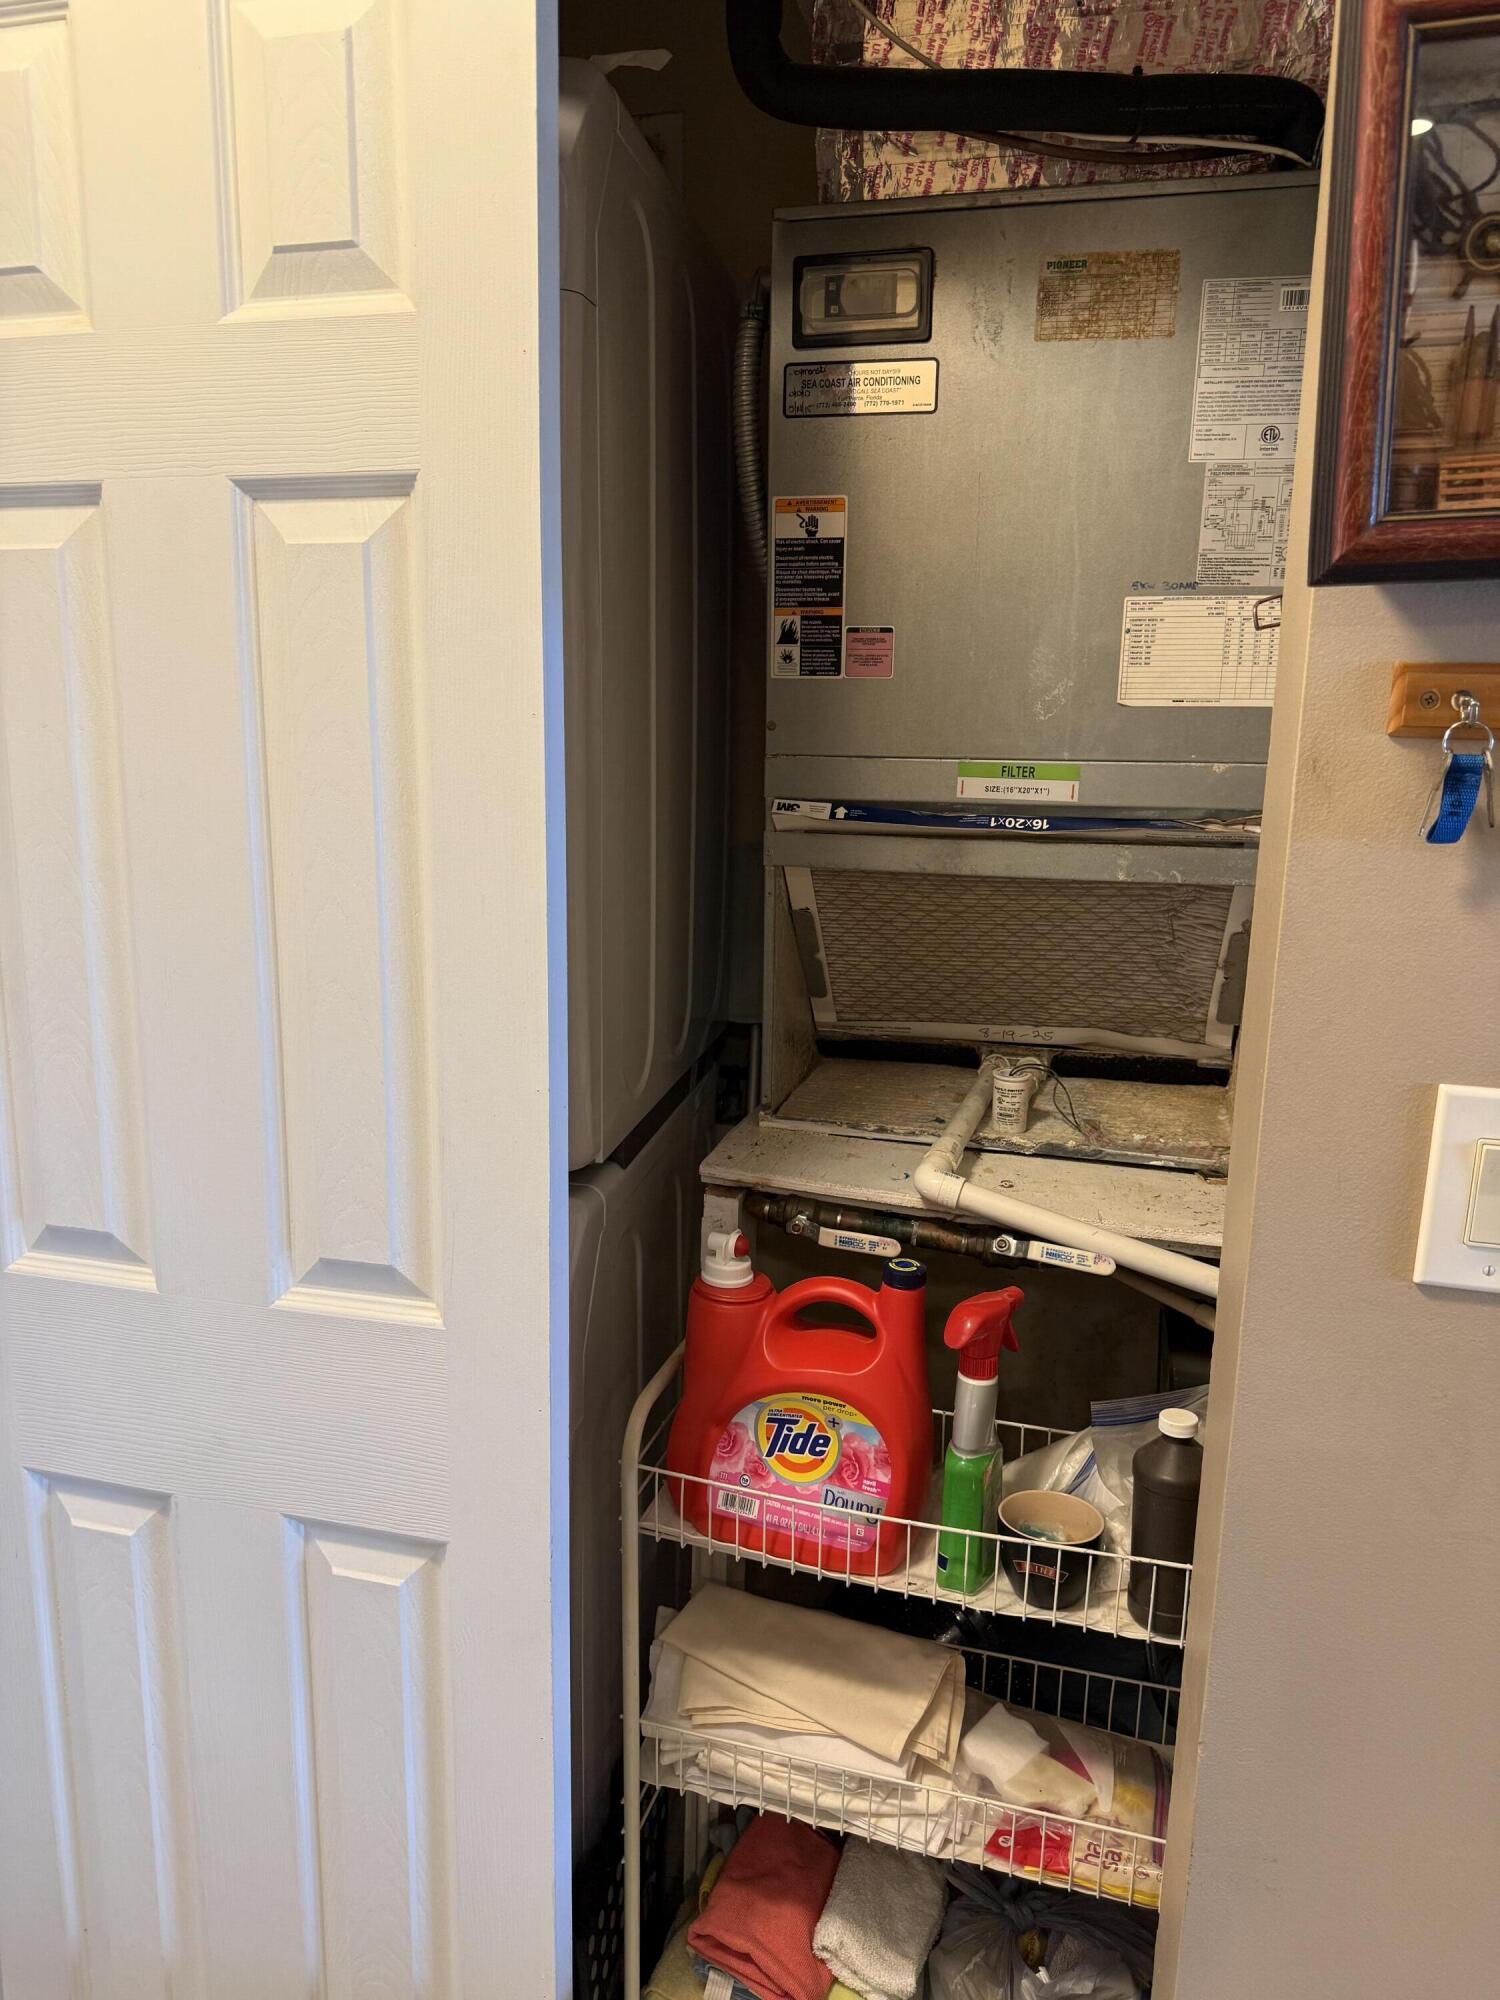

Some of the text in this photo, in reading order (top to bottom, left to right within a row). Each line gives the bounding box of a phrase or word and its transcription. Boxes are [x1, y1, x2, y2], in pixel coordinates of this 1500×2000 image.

[1046, 259, 1088, 270] PIONEER
[801, 375, 921, 389] SEA COAST AIR CONDITIONING
[1001, 765, 1036, 779] FILTER
[777, 801, 801, 812] 3M
[801, 1396, 847, 1408] more power
[763, 1416, 832, 1458] Tide
[823, 1488, 881, 1525] Downy
